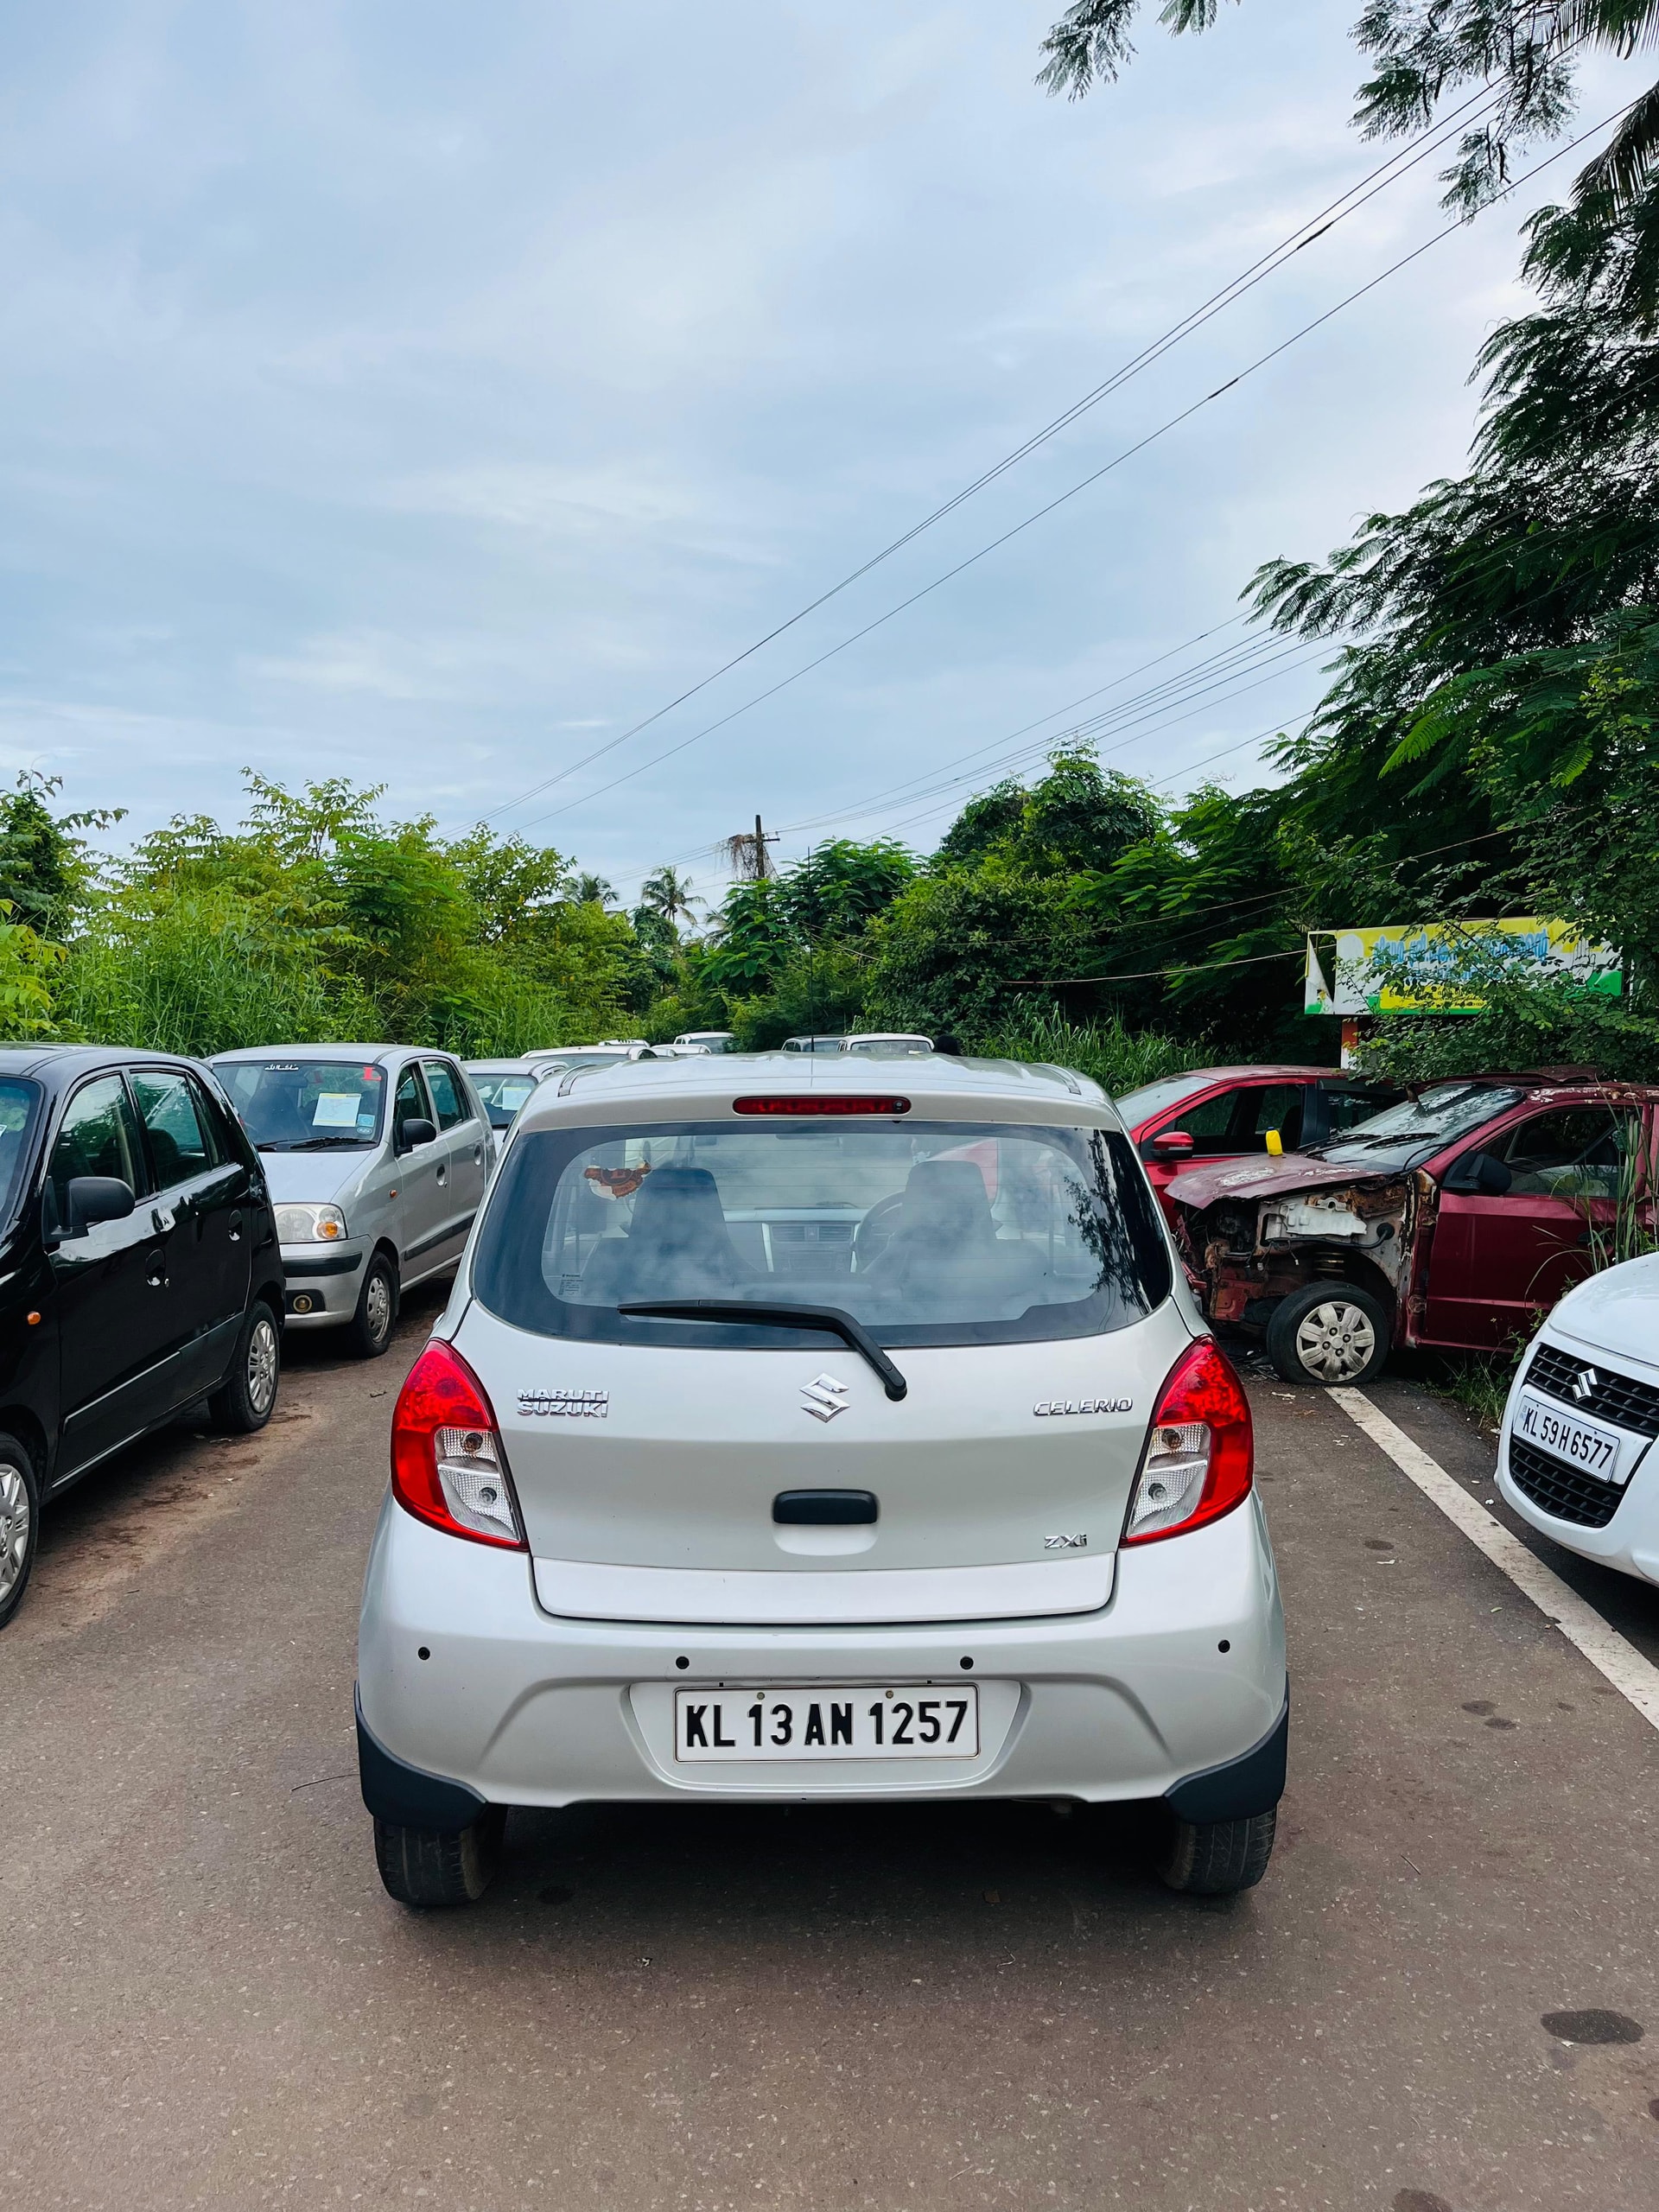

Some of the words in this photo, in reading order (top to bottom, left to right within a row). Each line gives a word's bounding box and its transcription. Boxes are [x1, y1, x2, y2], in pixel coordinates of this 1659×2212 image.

[361, 1066, 382, 1081] L
[517, 1389, 610, 1402] MARUTI
[517, 1402, 608, 1418] SUZUKI
[1033, 1397, 1133, 1416] CELERIO
[1522, 1408, 1538, 1437] KL
[1541, 1415, 1559, 1445] 59
[1558, 1425, 1571, 1452] H
[1570, 1431, 1614, 1469] 6577
[1044, 1534, 1088, 1549] ZXi
[686, 1704, 736, 1747] KL
[748, 1704, 793, 1746] 13
[804, 1702, 854, 1745] AN
[868, 1700, 969, 1745] 1257
